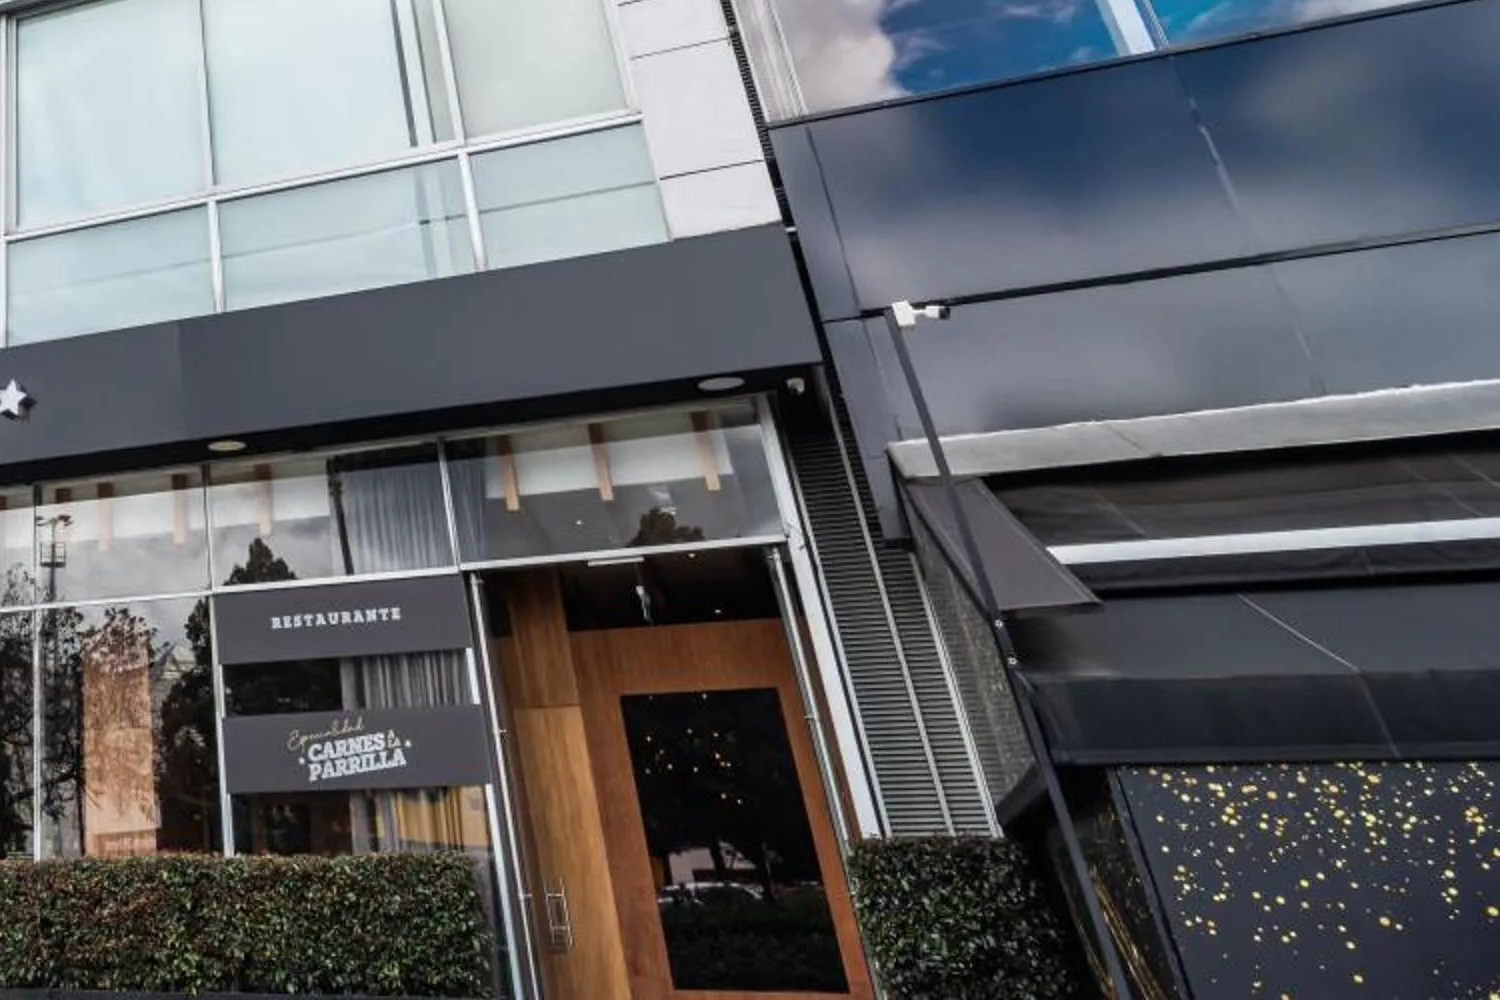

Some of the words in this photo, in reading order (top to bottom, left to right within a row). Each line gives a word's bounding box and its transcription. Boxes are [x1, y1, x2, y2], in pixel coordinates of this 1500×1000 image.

[271, 607, 402, 630] RESTAURANTE
[307, 732, 386, 762] CARNES
[307, 748, 407, 783] PARRILLA
